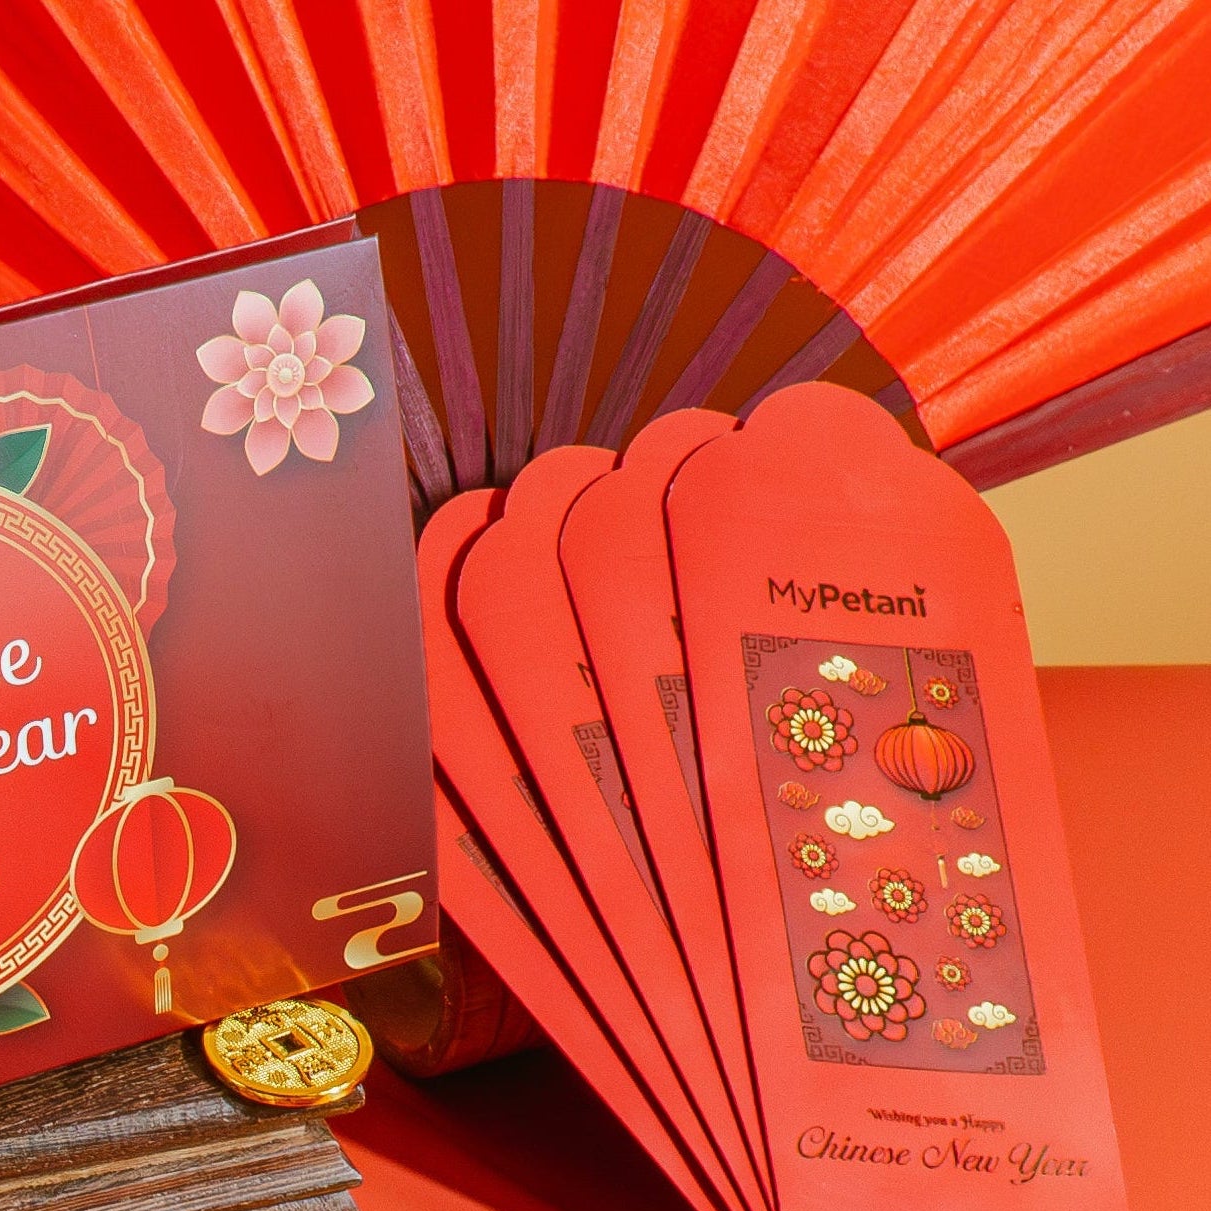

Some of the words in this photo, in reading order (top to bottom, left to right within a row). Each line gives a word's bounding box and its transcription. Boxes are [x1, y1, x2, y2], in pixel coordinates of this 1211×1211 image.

[767, 577, 927, 618] MyPetani
[867, 1108, 921, 1127] Wishing
[922, 1115, 948, 1127] you
[959, 1113, 1006, 1133] Happy
[796, 1125, 912, 1166] Chinese
[921, 1137, 1000, 1173] New
[1008, 1142, 1090, 1185] Year
